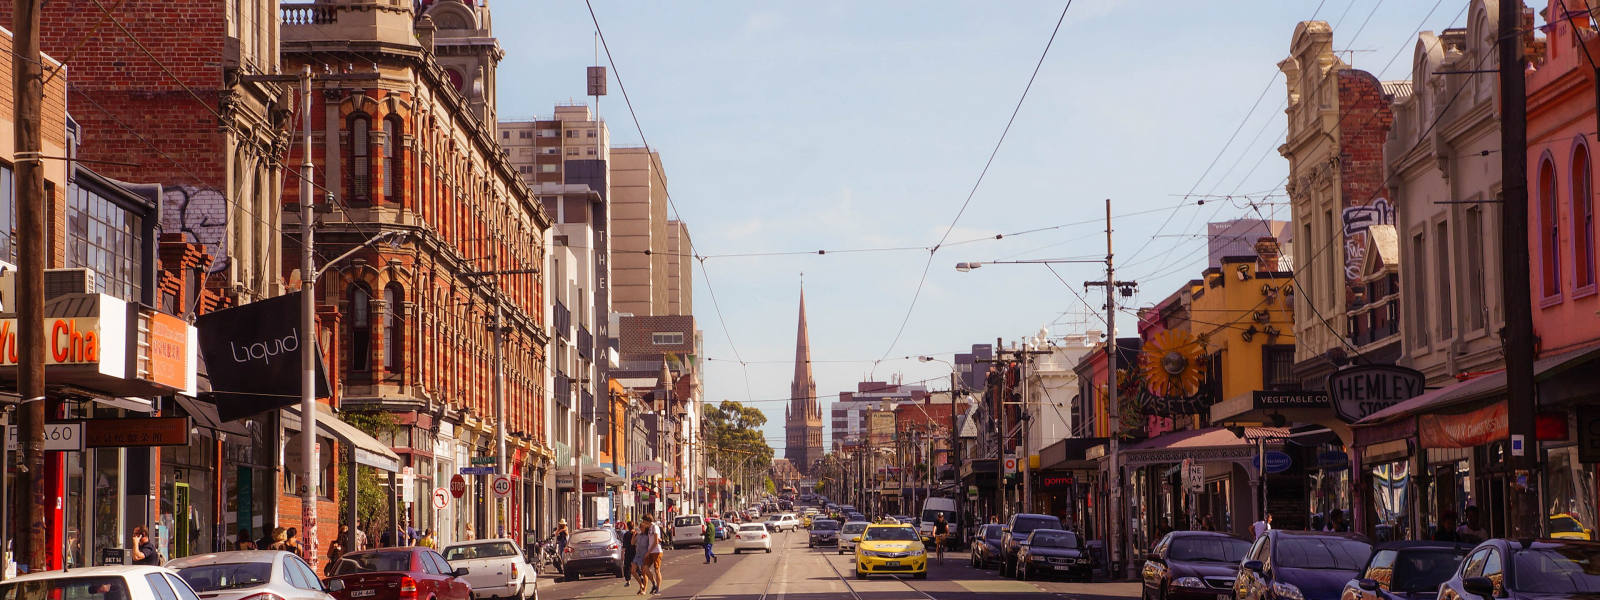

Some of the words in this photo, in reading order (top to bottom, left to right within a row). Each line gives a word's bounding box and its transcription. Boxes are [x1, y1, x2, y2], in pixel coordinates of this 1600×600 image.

[51, 318, 98, 363] Cha
[599, 325, 608, 384] MAX
[1340, 373, 1416, 401] HEMLEY
[1261, 395, 1313, 404] VEGETABLE
[1191, 466, 1201, 474] NE
[451, 480, 465, 491] STOP
[495, 481, 508, 490] 40
